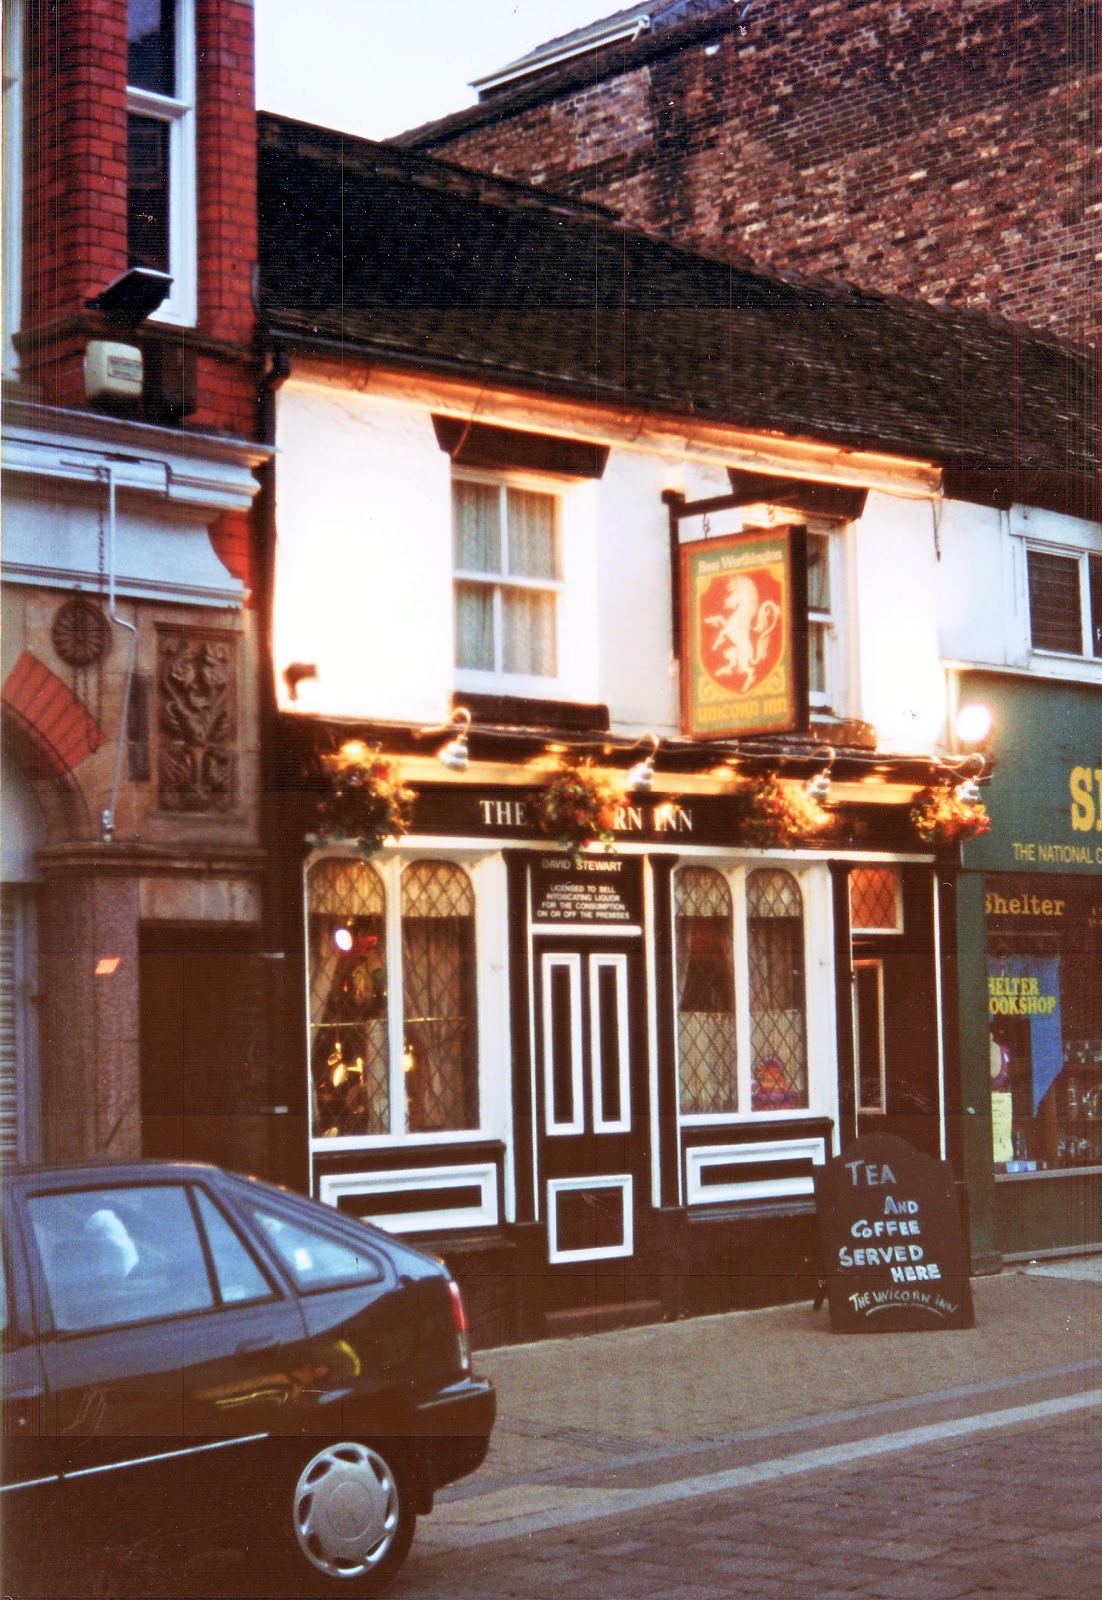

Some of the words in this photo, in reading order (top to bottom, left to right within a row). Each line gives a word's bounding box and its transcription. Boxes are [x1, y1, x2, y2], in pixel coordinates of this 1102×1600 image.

[479, 800, 527, 825] THE
[1013, 843, 1035, 861] THE
[1038, 844, 1094, 864] NATIONAL
[542, 859, 571, 869] DAVID
[576, 861, 623, 872] STEWART
[587, 885, 597, 893] TO
[537, 910, 548, 918] ON
[551, 910, 561, 918] OR
[563, 910, 577, 918] OFF
[581, 911, 593, 919] THE
[541, 901, 557, 909] FOR
[560, 901, 573, 909] THE
[987, 977, 1039, 996] HELTER
[988, 996, 1056, 1015] OOKSHOP
[845, 1160, 897, 1186] TEA
[851, 1219, 921, 1239] COFFEE
[838, 1245, 924, 1267] SERVED
[890, 1264, 942, 1283] HERE
[848, 1292, 871, 1312] THE
